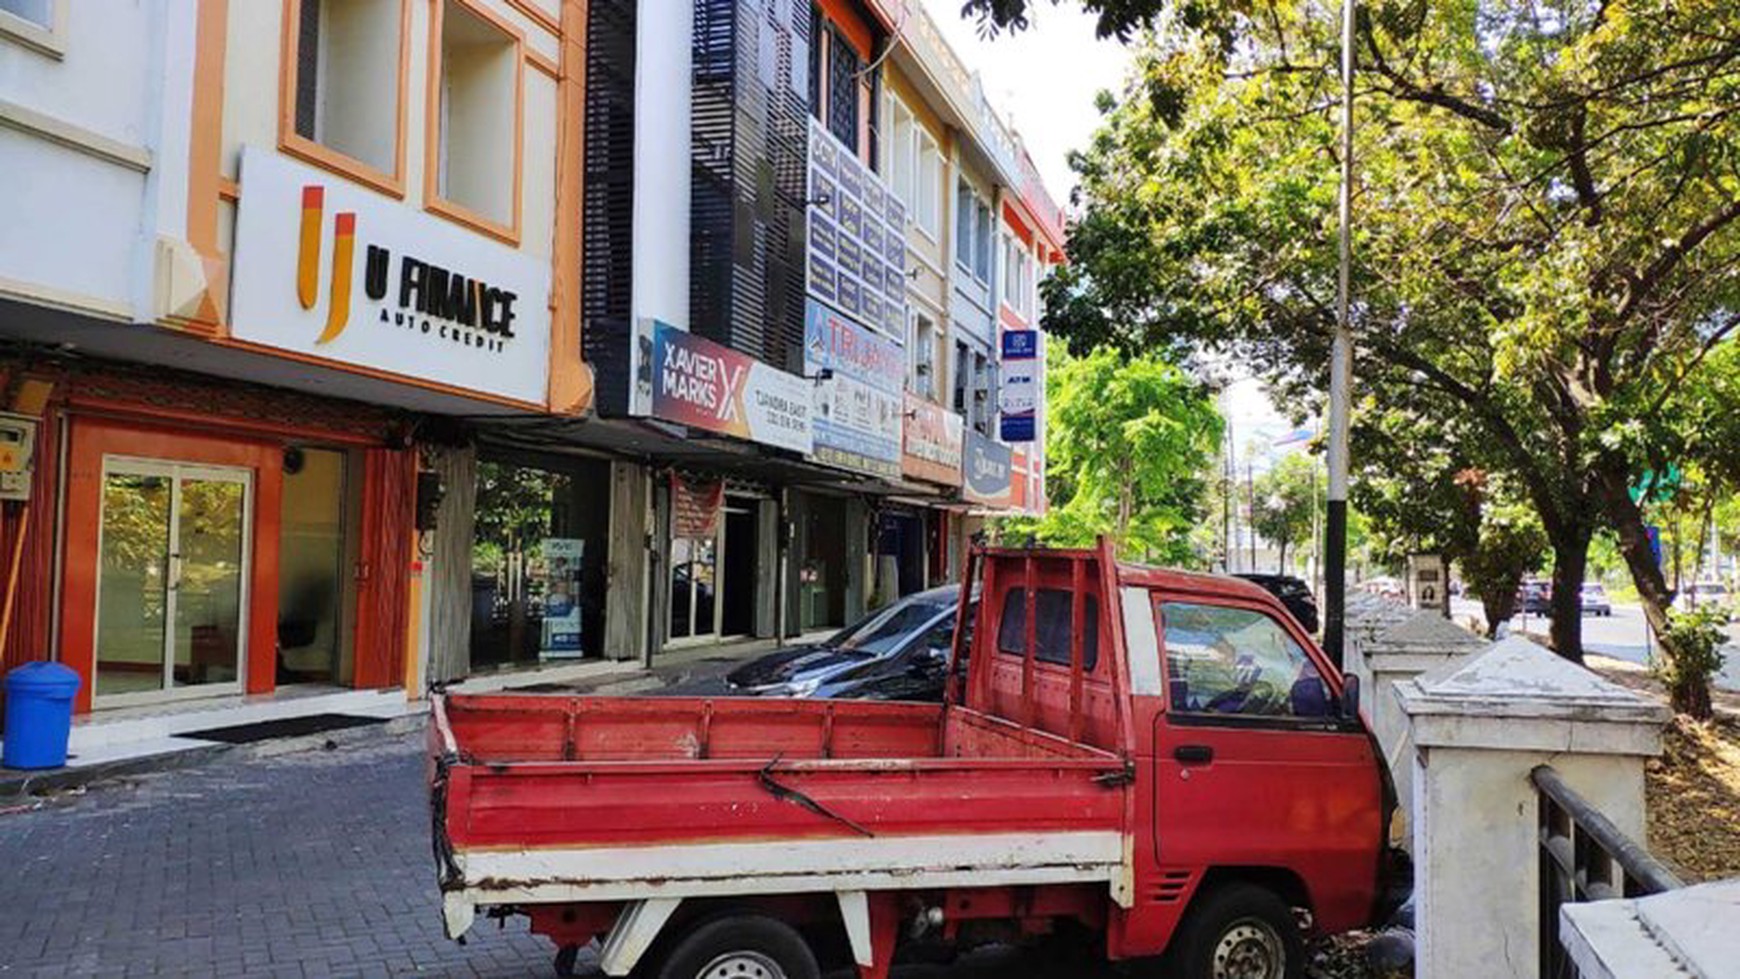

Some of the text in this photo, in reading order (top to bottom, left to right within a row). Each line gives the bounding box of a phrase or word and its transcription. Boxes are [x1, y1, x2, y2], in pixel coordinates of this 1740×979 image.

[365, 244, 516, 337] U FINANCE
[380, 308, 504, 352] AUTO CREDIT
[664, 341, 718, 384] XAVIER
[1007, 376, 1031, 384] ATM
[662, 369, 718, 410] MARKS
